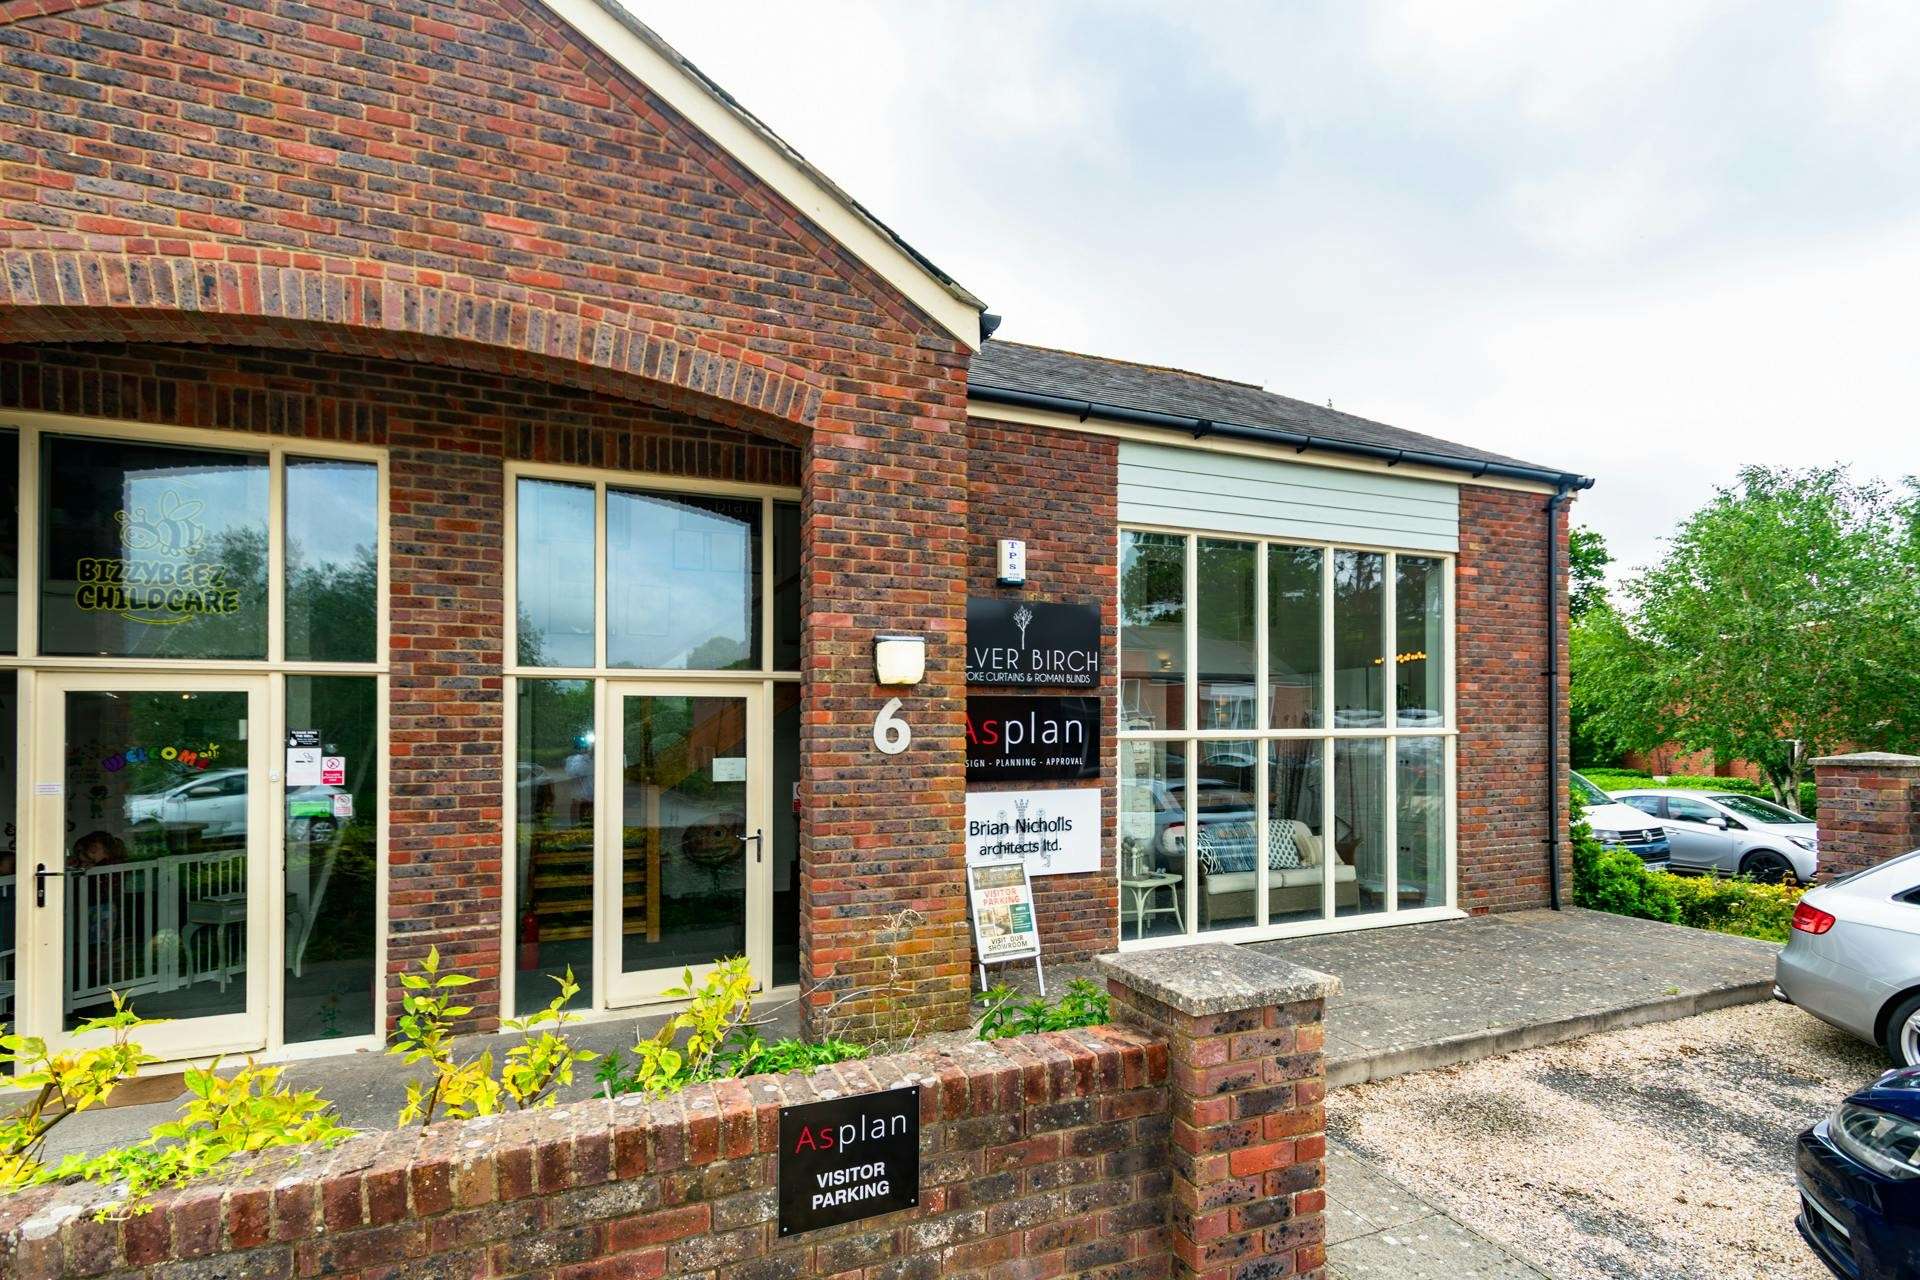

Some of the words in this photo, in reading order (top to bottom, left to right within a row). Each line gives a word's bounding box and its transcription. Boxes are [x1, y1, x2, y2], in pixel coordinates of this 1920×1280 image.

[77, 558, 226, 588] BIZZYBEEZ
[75, 583, 241, 614] CHILDCARE
[1032, 649, 1098, 671] BIRCH
[986, 671, 1024, 682] CURTAINS
[1026, 673, 1033, 682] &
[1035, 673, 1065, 683] ROMAN
[1066, 674, 1091, 683] BLINDS
[873, 696, 911, 755] 6
[995, 758, 1036, 767] PLANNING
[1046, 757, 1083, 766] APPROVAL
[969, 820, 1009, 836] Brian
[1015, 816, 1073, 833] Nicholls
[979, 840, 1040, 856] architects
[1043, 838, 1062, 852] ltd.
[988, 940, 1028, 952] SHOWROOM
[991, 936, 1006, 945] VISIT
[1010, 934, 1024, 942] OUR
[794, 1114, 907, 1154] Asplan
[816, 1161, 886, 1189] VISITOR
[811, 1180, 890, 1211] PARKING
